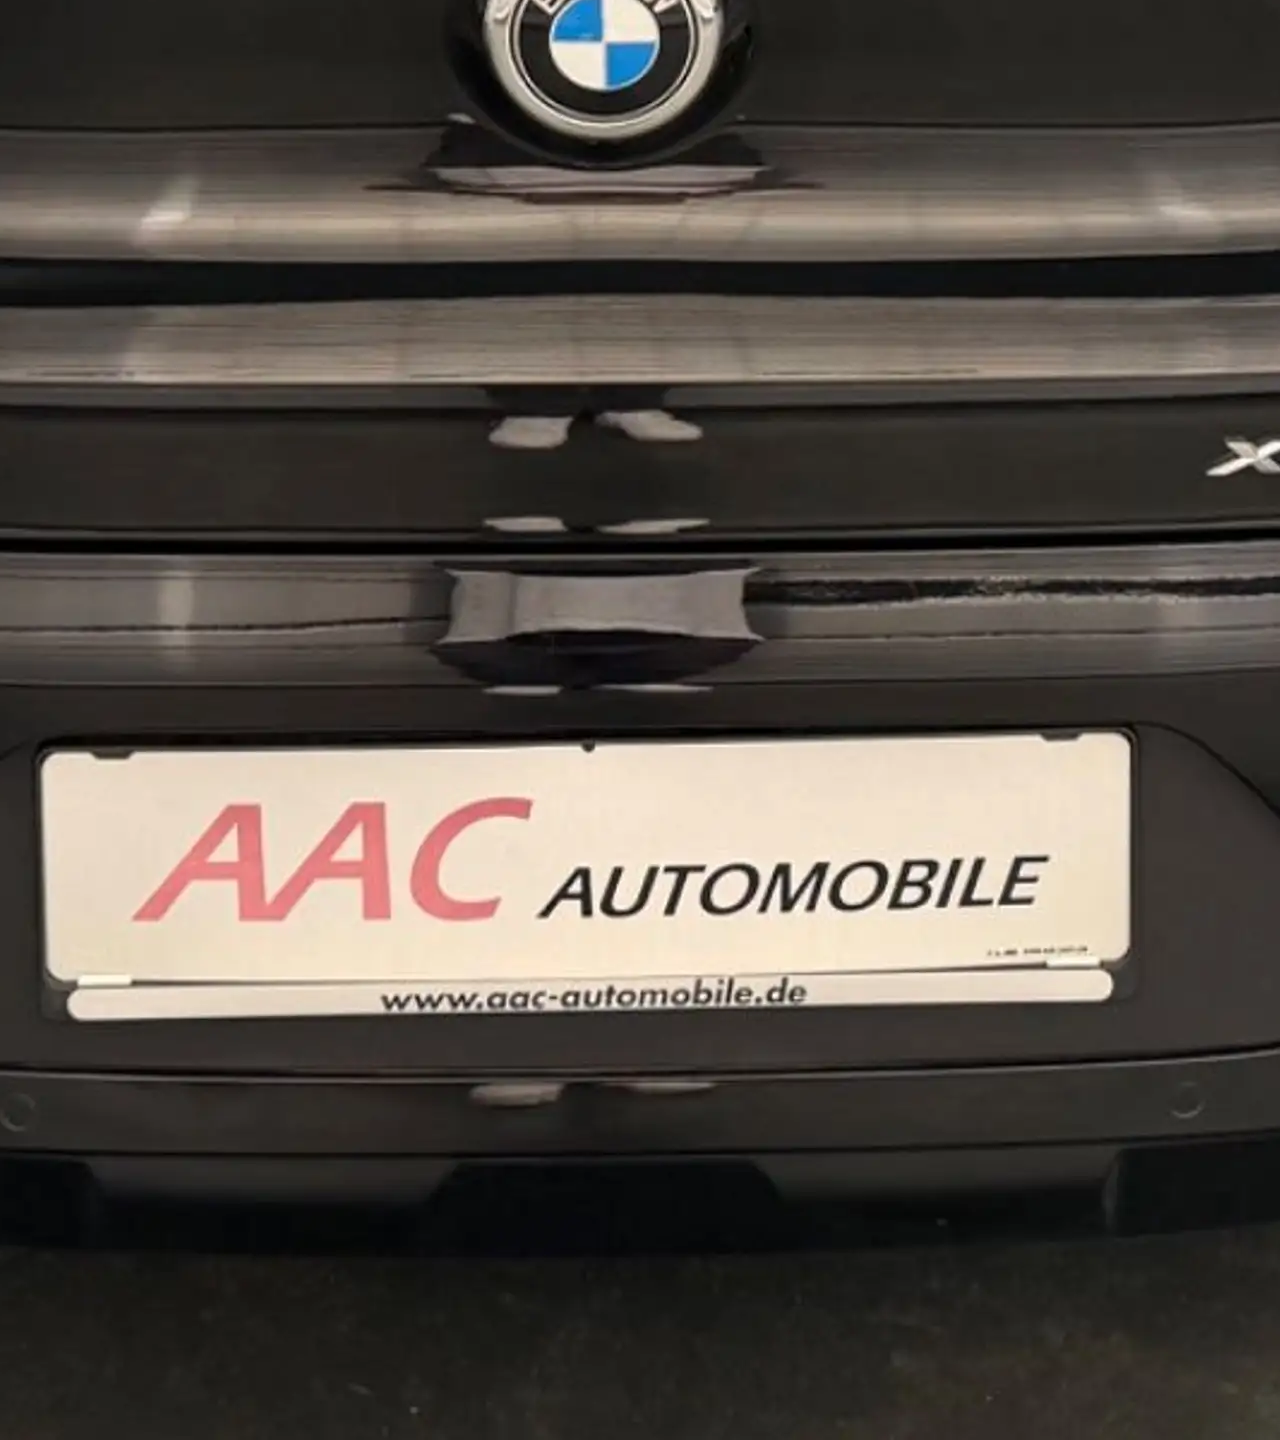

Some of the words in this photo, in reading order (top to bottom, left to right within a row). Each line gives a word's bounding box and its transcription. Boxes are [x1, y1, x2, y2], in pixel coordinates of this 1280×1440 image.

[130, 796, 534, 923] AAC
[536, 853, 1050, 920] AUTOMOBILE
[380, 976, 808, 1013] www.aac-automobile.de
